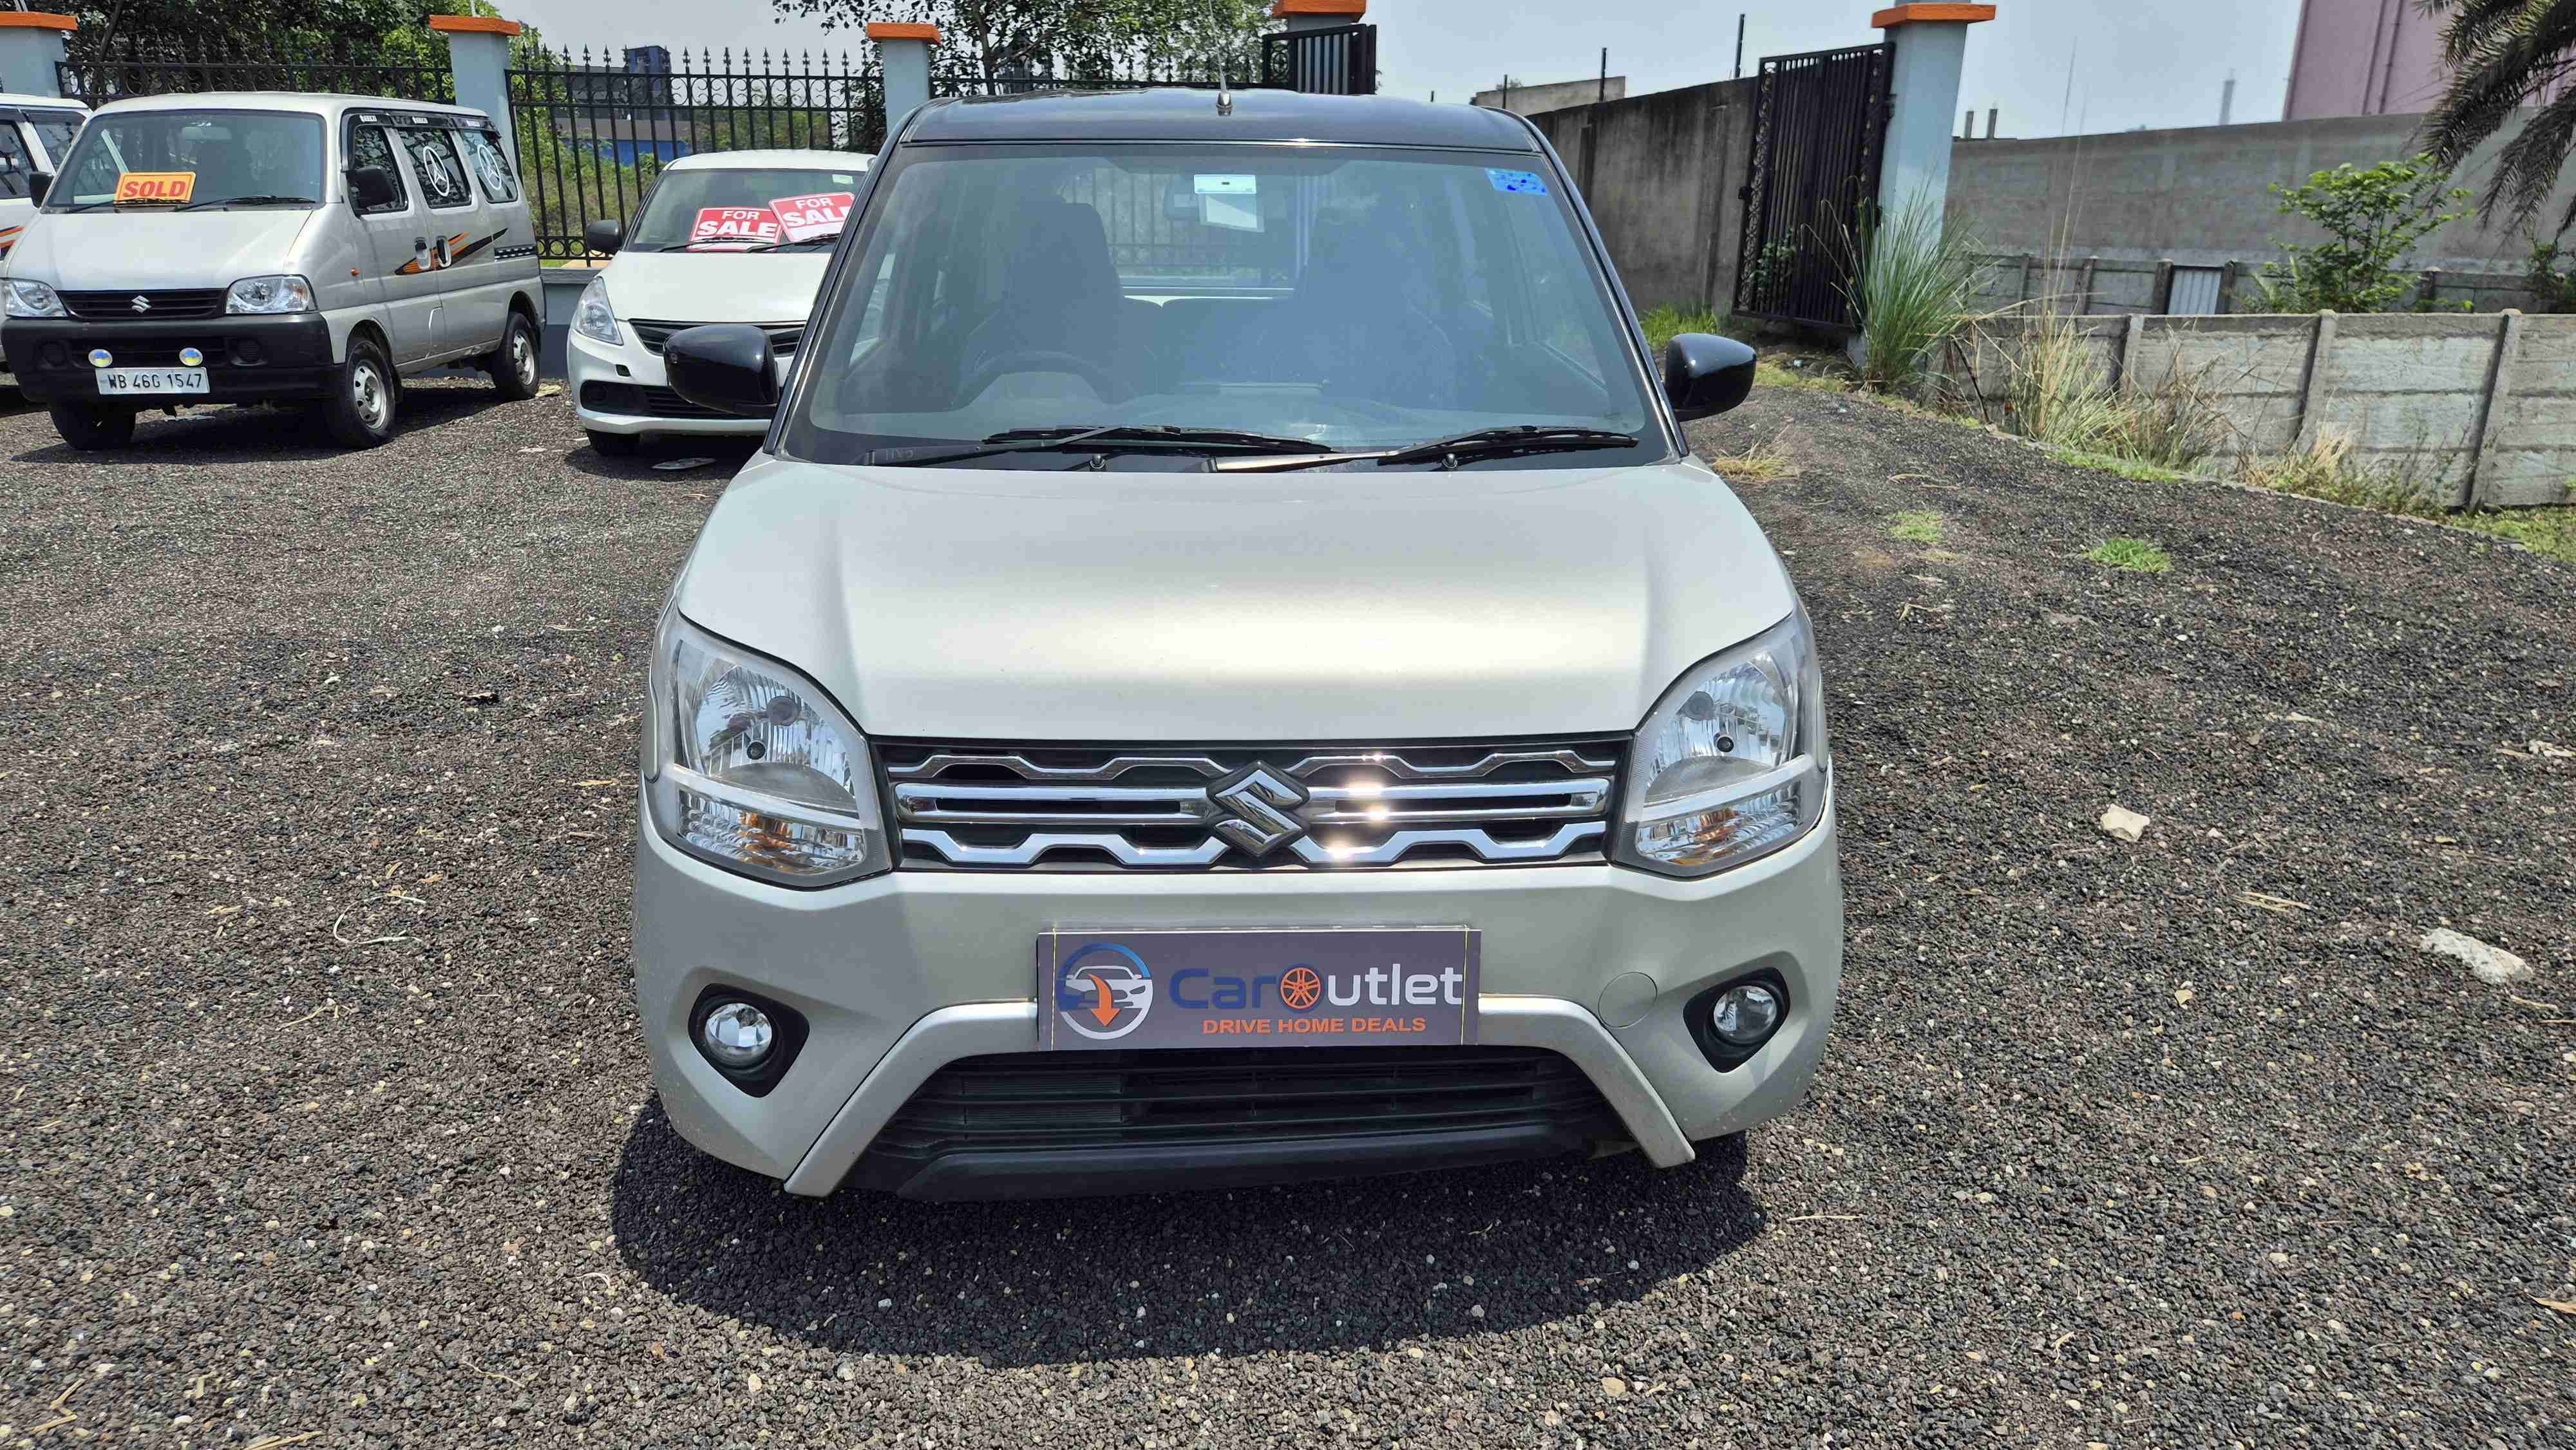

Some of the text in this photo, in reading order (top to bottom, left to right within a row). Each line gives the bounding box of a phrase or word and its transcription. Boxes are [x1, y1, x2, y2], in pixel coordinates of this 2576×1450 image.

[122, 181, 186, 197] SOLD
[795, 197, 835, 210] FOR
[721, 211, 760, 220] FOR
[697, 221, 777, 237] SALE
[108, 373, 127, 389] WB
[167, 373, 202, 389] 1547
[1202, 1017, 1426, 1034] DRIVE HOME DEALS
